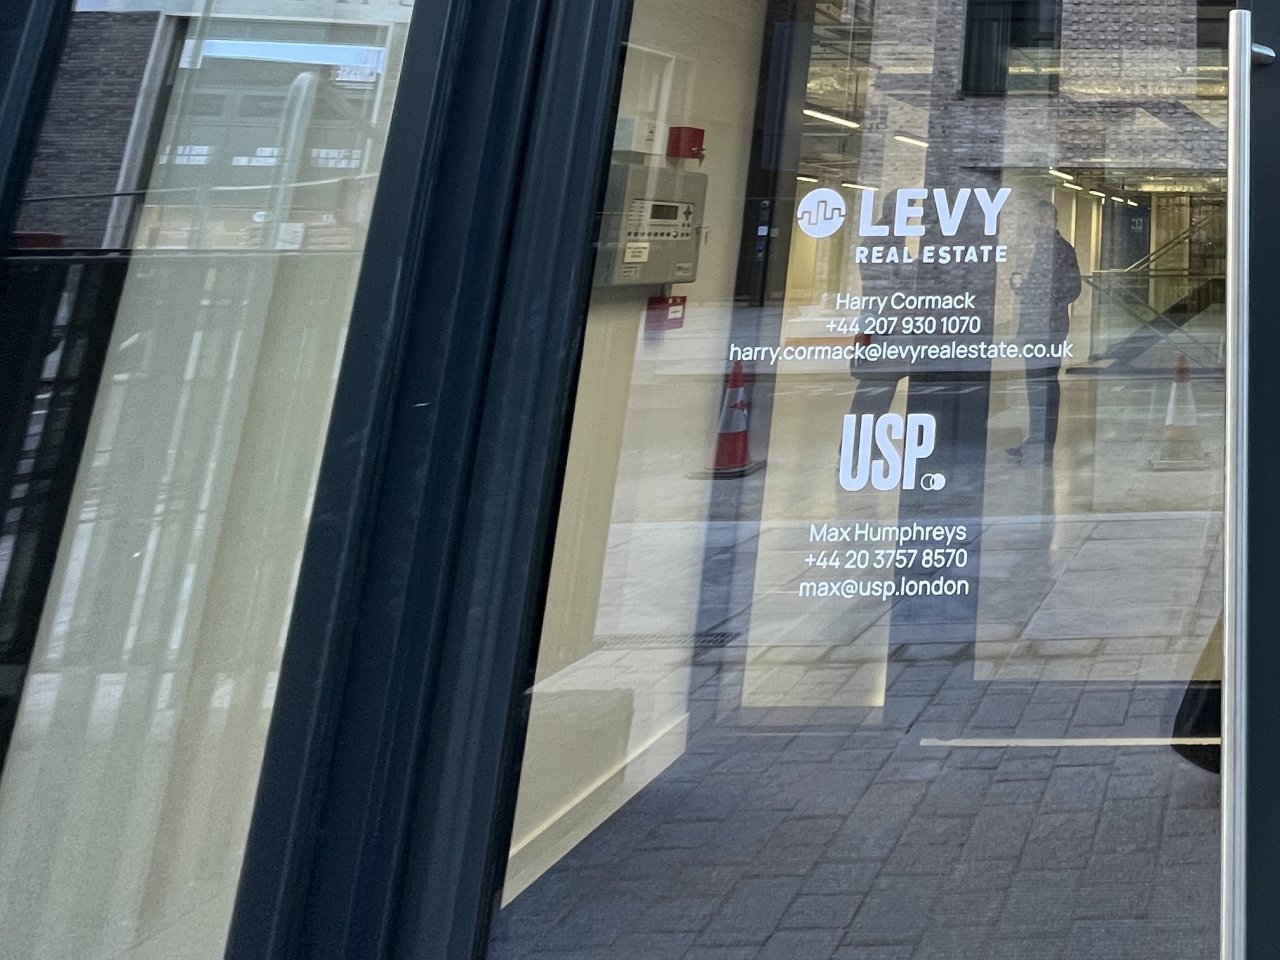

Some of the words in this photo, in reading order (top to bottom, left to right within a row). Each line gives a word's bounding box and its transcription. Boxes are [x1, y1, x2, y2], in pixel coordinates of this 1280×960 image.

[859, 187, 1012, 237] LEVY
[855, 246, 915, 264] REAL
[922, 245, 1008, 264] ESTATE
[835, 292, 888, 314] Harry
[891, 292, 976, 310] Cormack
[826, 317, 860, 335] +44
[864, 316, 897, 335] 207
[899, 316, 937, 335] 930
[940, 316, 981, 335] 1070
[729, 341, 1074, 365] harry.cormack@levyrealestate.co.uk
[810, 523, 851, 541] Max
[854, 522, 967, 545] Humphreys
[804, 551, 841, 569] +44
[845, 550, 870, 569] 20
[873, 550, 918, 569] 3757
[921, 549, 968, 568] 8570
[799, 577, 969, 600] max@usp.london
